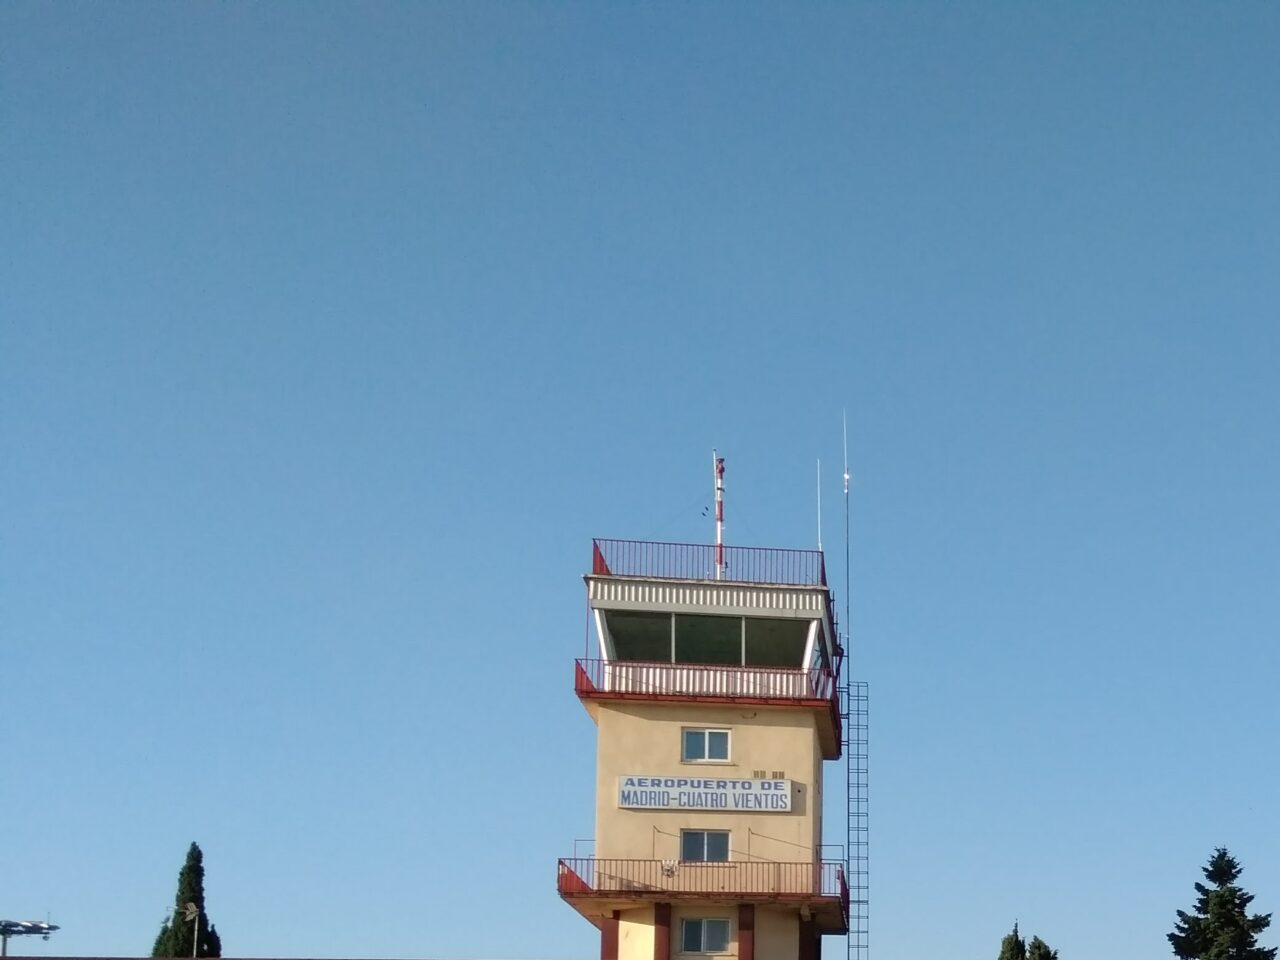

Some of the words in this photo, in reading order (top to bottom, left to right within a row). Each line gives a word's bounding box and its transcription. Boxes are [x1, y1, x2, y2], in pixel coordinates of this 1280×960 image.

[625, 778, 753, 790] AEROPUERTO
[761, 781, 785, 791] DE
[621, 790, 728, 808] MADRID-CUATRO
[733, 793, 788, 809] VIENTOS
